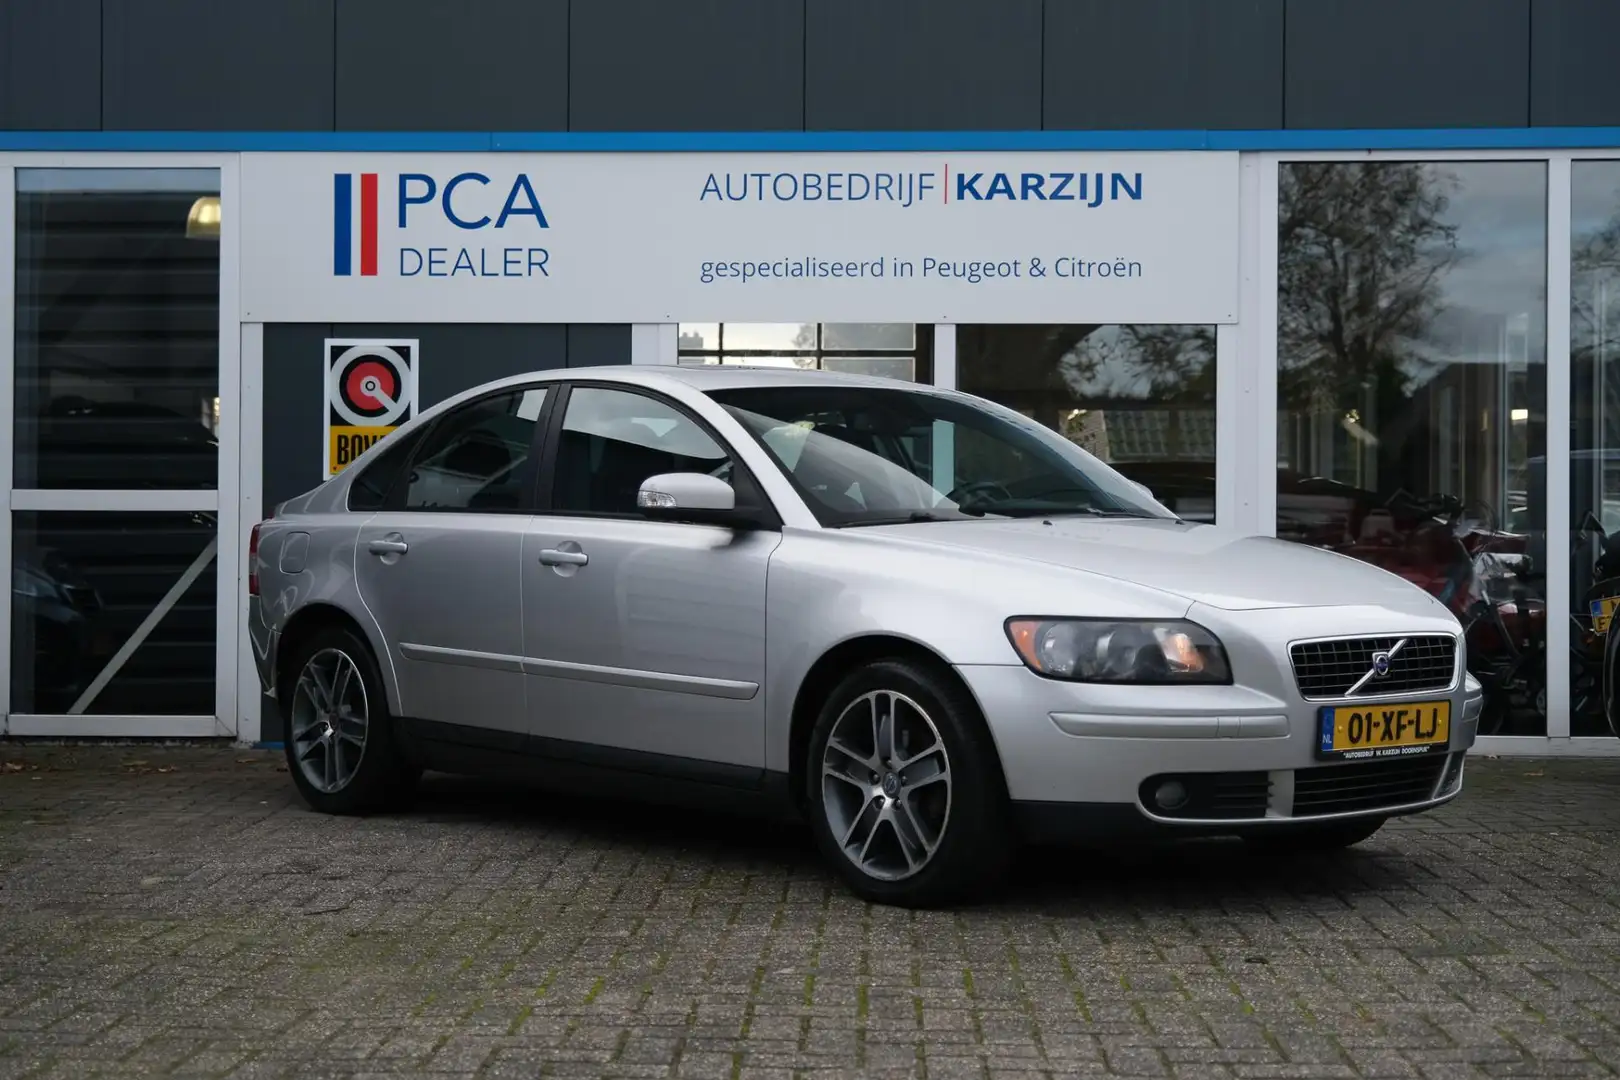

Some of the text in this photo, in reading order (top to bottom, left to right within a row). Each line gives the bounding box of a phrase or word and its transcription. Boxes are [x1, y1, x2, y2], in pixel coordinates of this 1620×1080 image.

[398, 172, 550, 230] PCA
[700, 172, 1143, 208] AUTOBEDRIJF KARZIJN
[400, 248, 549, 277] DEALER
[700, 256, 1142, 284] gespecialiseerd in Peugeot & Citroën
[337, 434, 387, 466] BOV
[1322, 734, 1332, 744] NL
[1348, 708, 1438, 744] 01-XF-LJ
